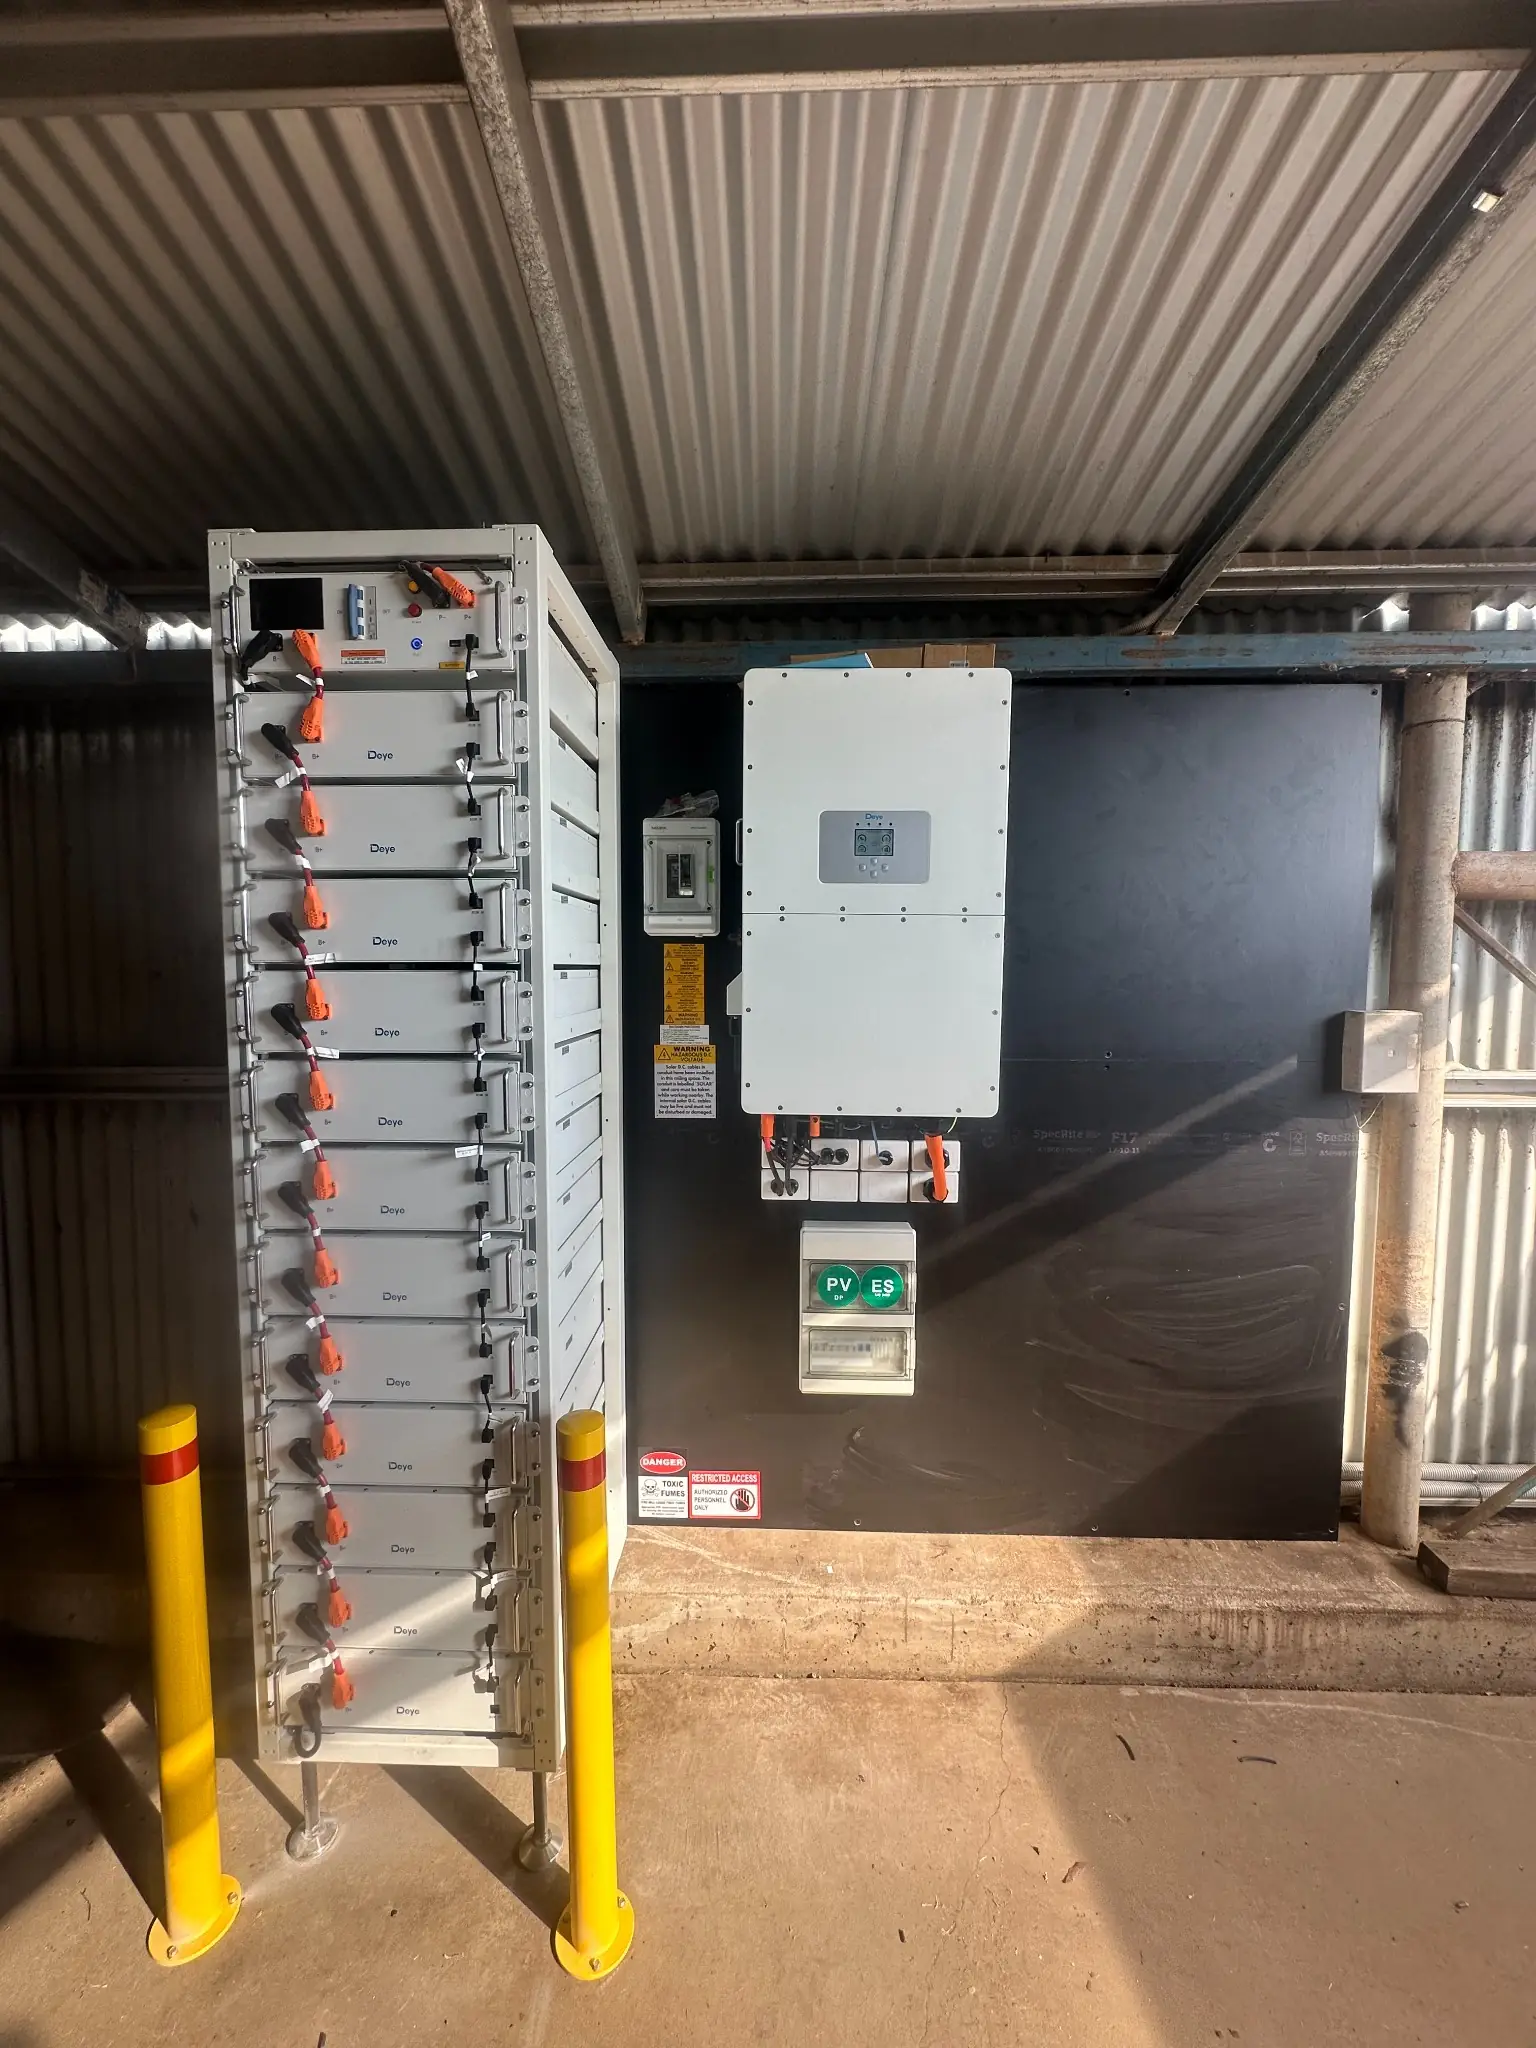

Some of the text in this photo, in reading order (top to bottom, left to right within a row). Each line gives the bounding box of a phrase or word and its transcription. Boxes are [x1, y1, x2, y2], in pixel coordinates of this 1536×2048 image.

[368, 751, 393, 761] Deye
[370, 844, 396, 854] Deye
[373, 936, 398, 946] Deye
[375, 1028, 400, 1037] Deye
[378, 1117, 403, 1127] Deye
[380, 1206, 405, 1215] Deye
[827, 1278, 894, 1293] PV ES
[383, 1292, 407, 1302] Deye
[386, 1378, 410, 1387] Deye
[388, 1462, 412, 1471] Deye
[692, 1474, 757, 1483] RESTRICTED ACCESS
[391, 1545, 415, 1554] Deye
[394, 1626, 417, 1636] Deye
[396, 1707, 419, 1716] Deye
